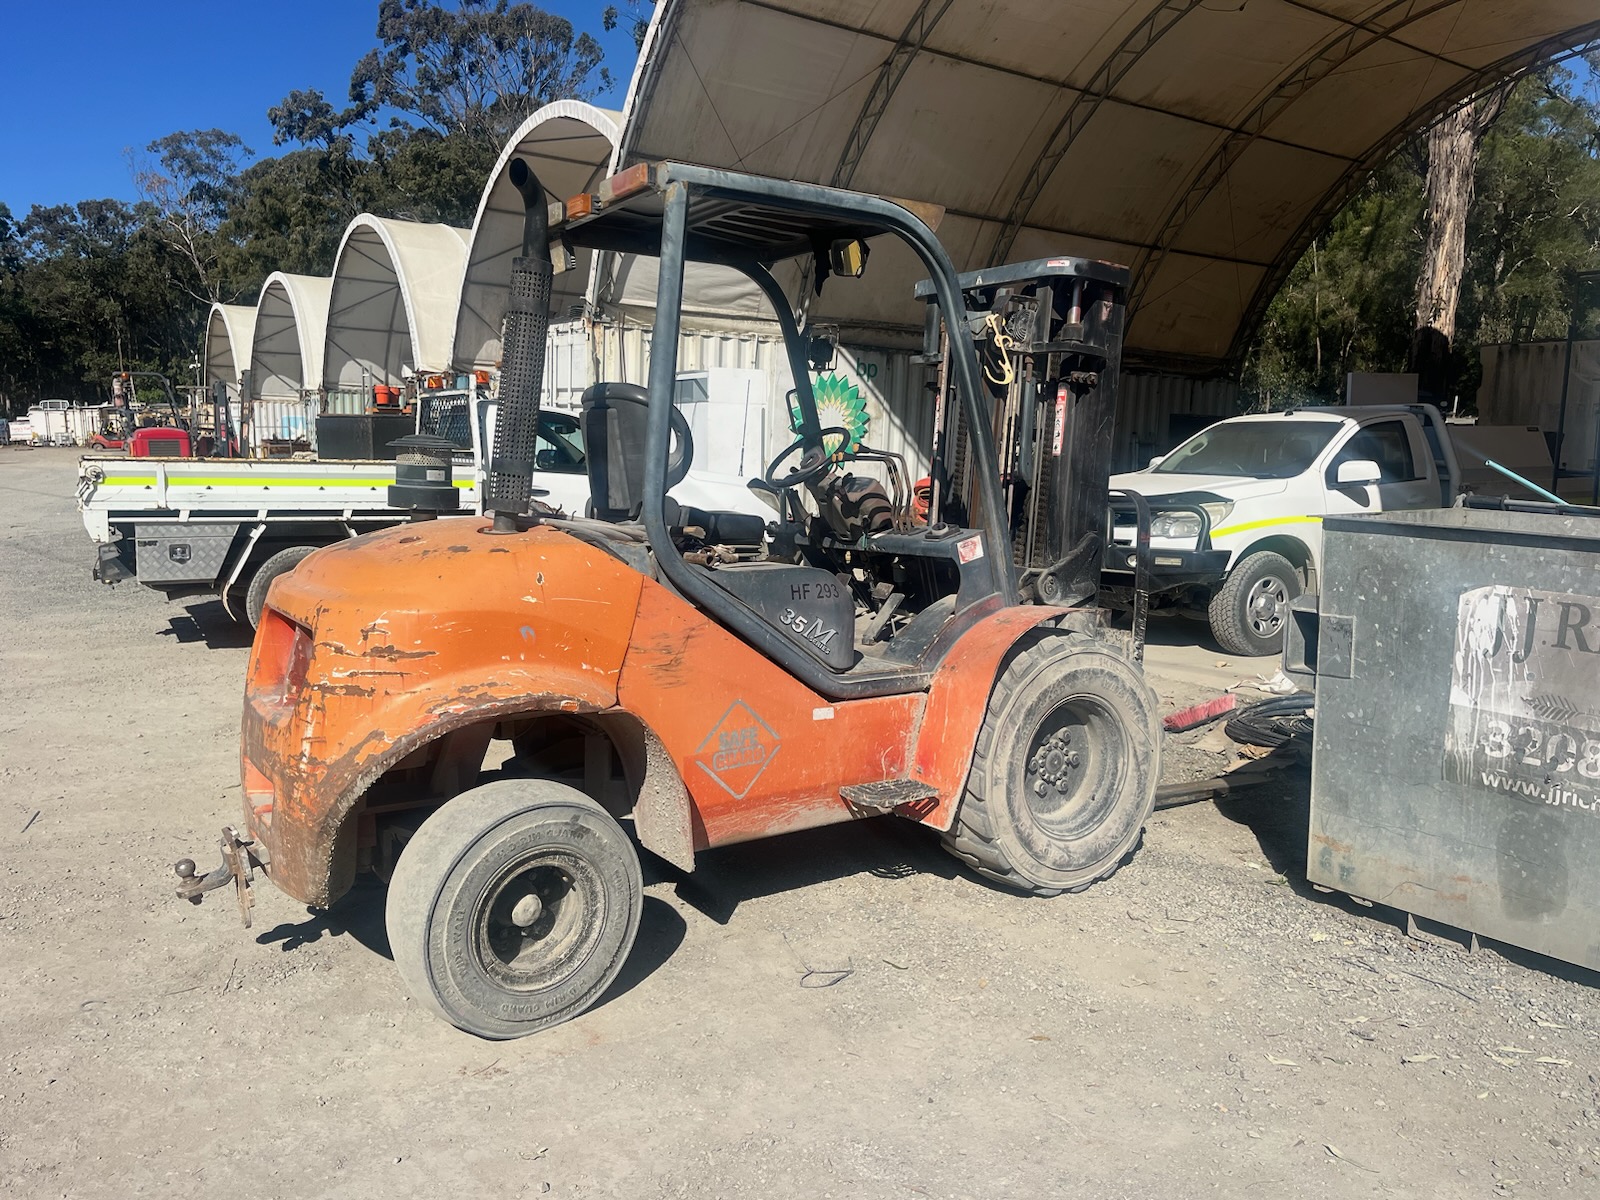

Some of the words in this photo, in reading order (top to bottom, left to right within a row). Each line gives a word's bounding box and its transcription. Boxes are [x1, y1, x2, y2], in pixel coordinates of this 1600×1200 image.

[857, 357, 878, 382] bp
[790, 584, 810, 600] HF
[815, 583, 840, 599] 293
